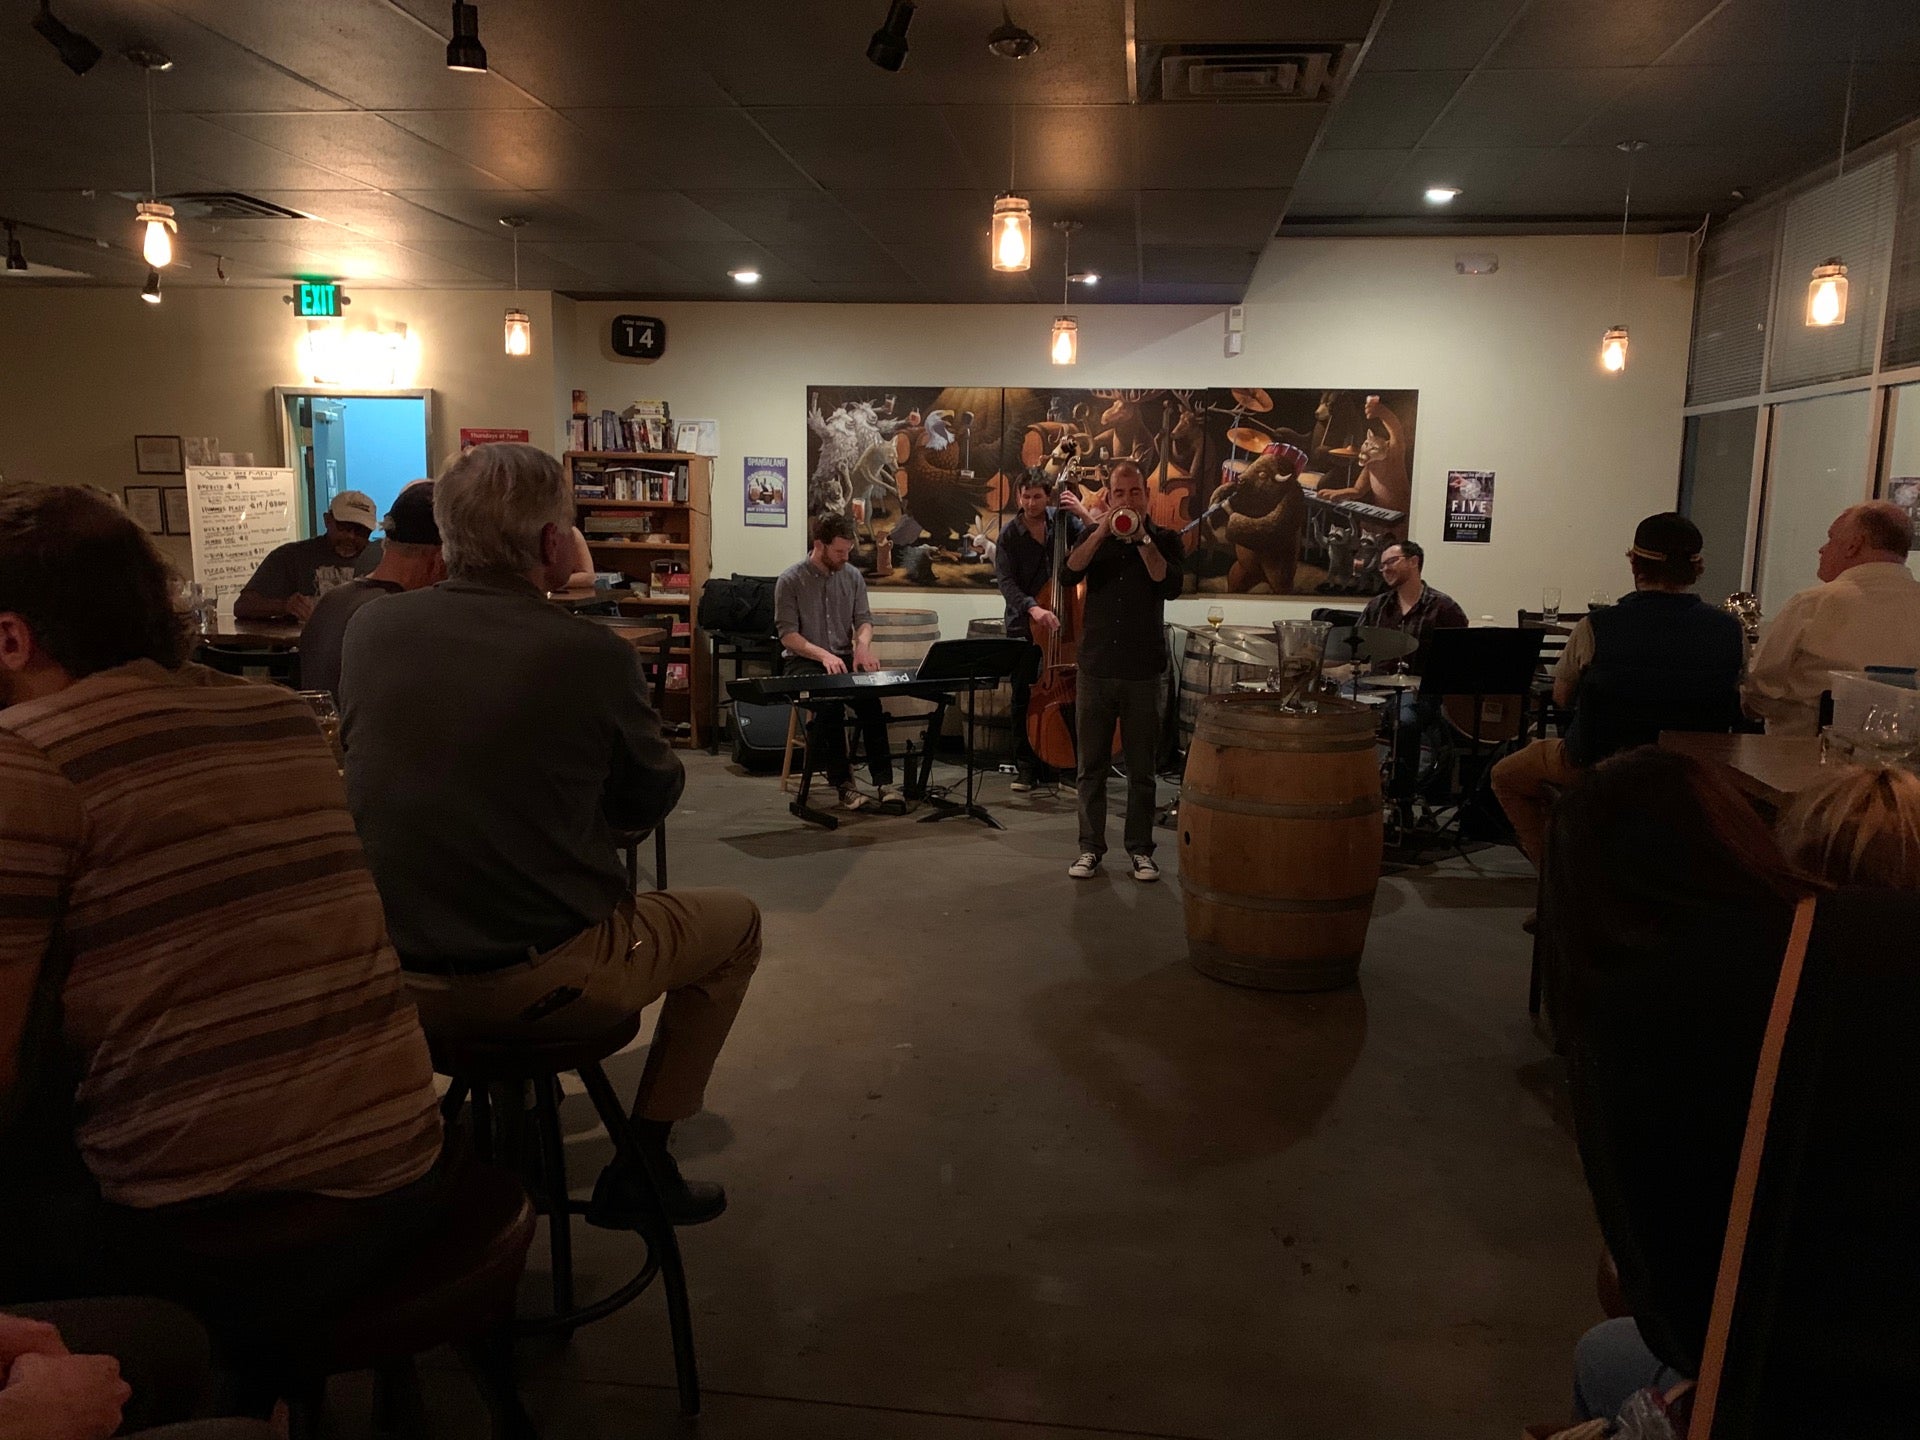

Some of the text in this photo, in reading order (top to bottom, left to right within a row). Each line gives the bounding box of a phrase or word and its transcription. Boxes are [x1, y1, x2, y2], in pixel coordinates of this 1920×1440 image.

[301, 285, 335, 315] EXIT
[626, 327, 654, 348] 14
[1451, 500, 1487, 513] FIVE
[868, 671, 910, 684] Rland
